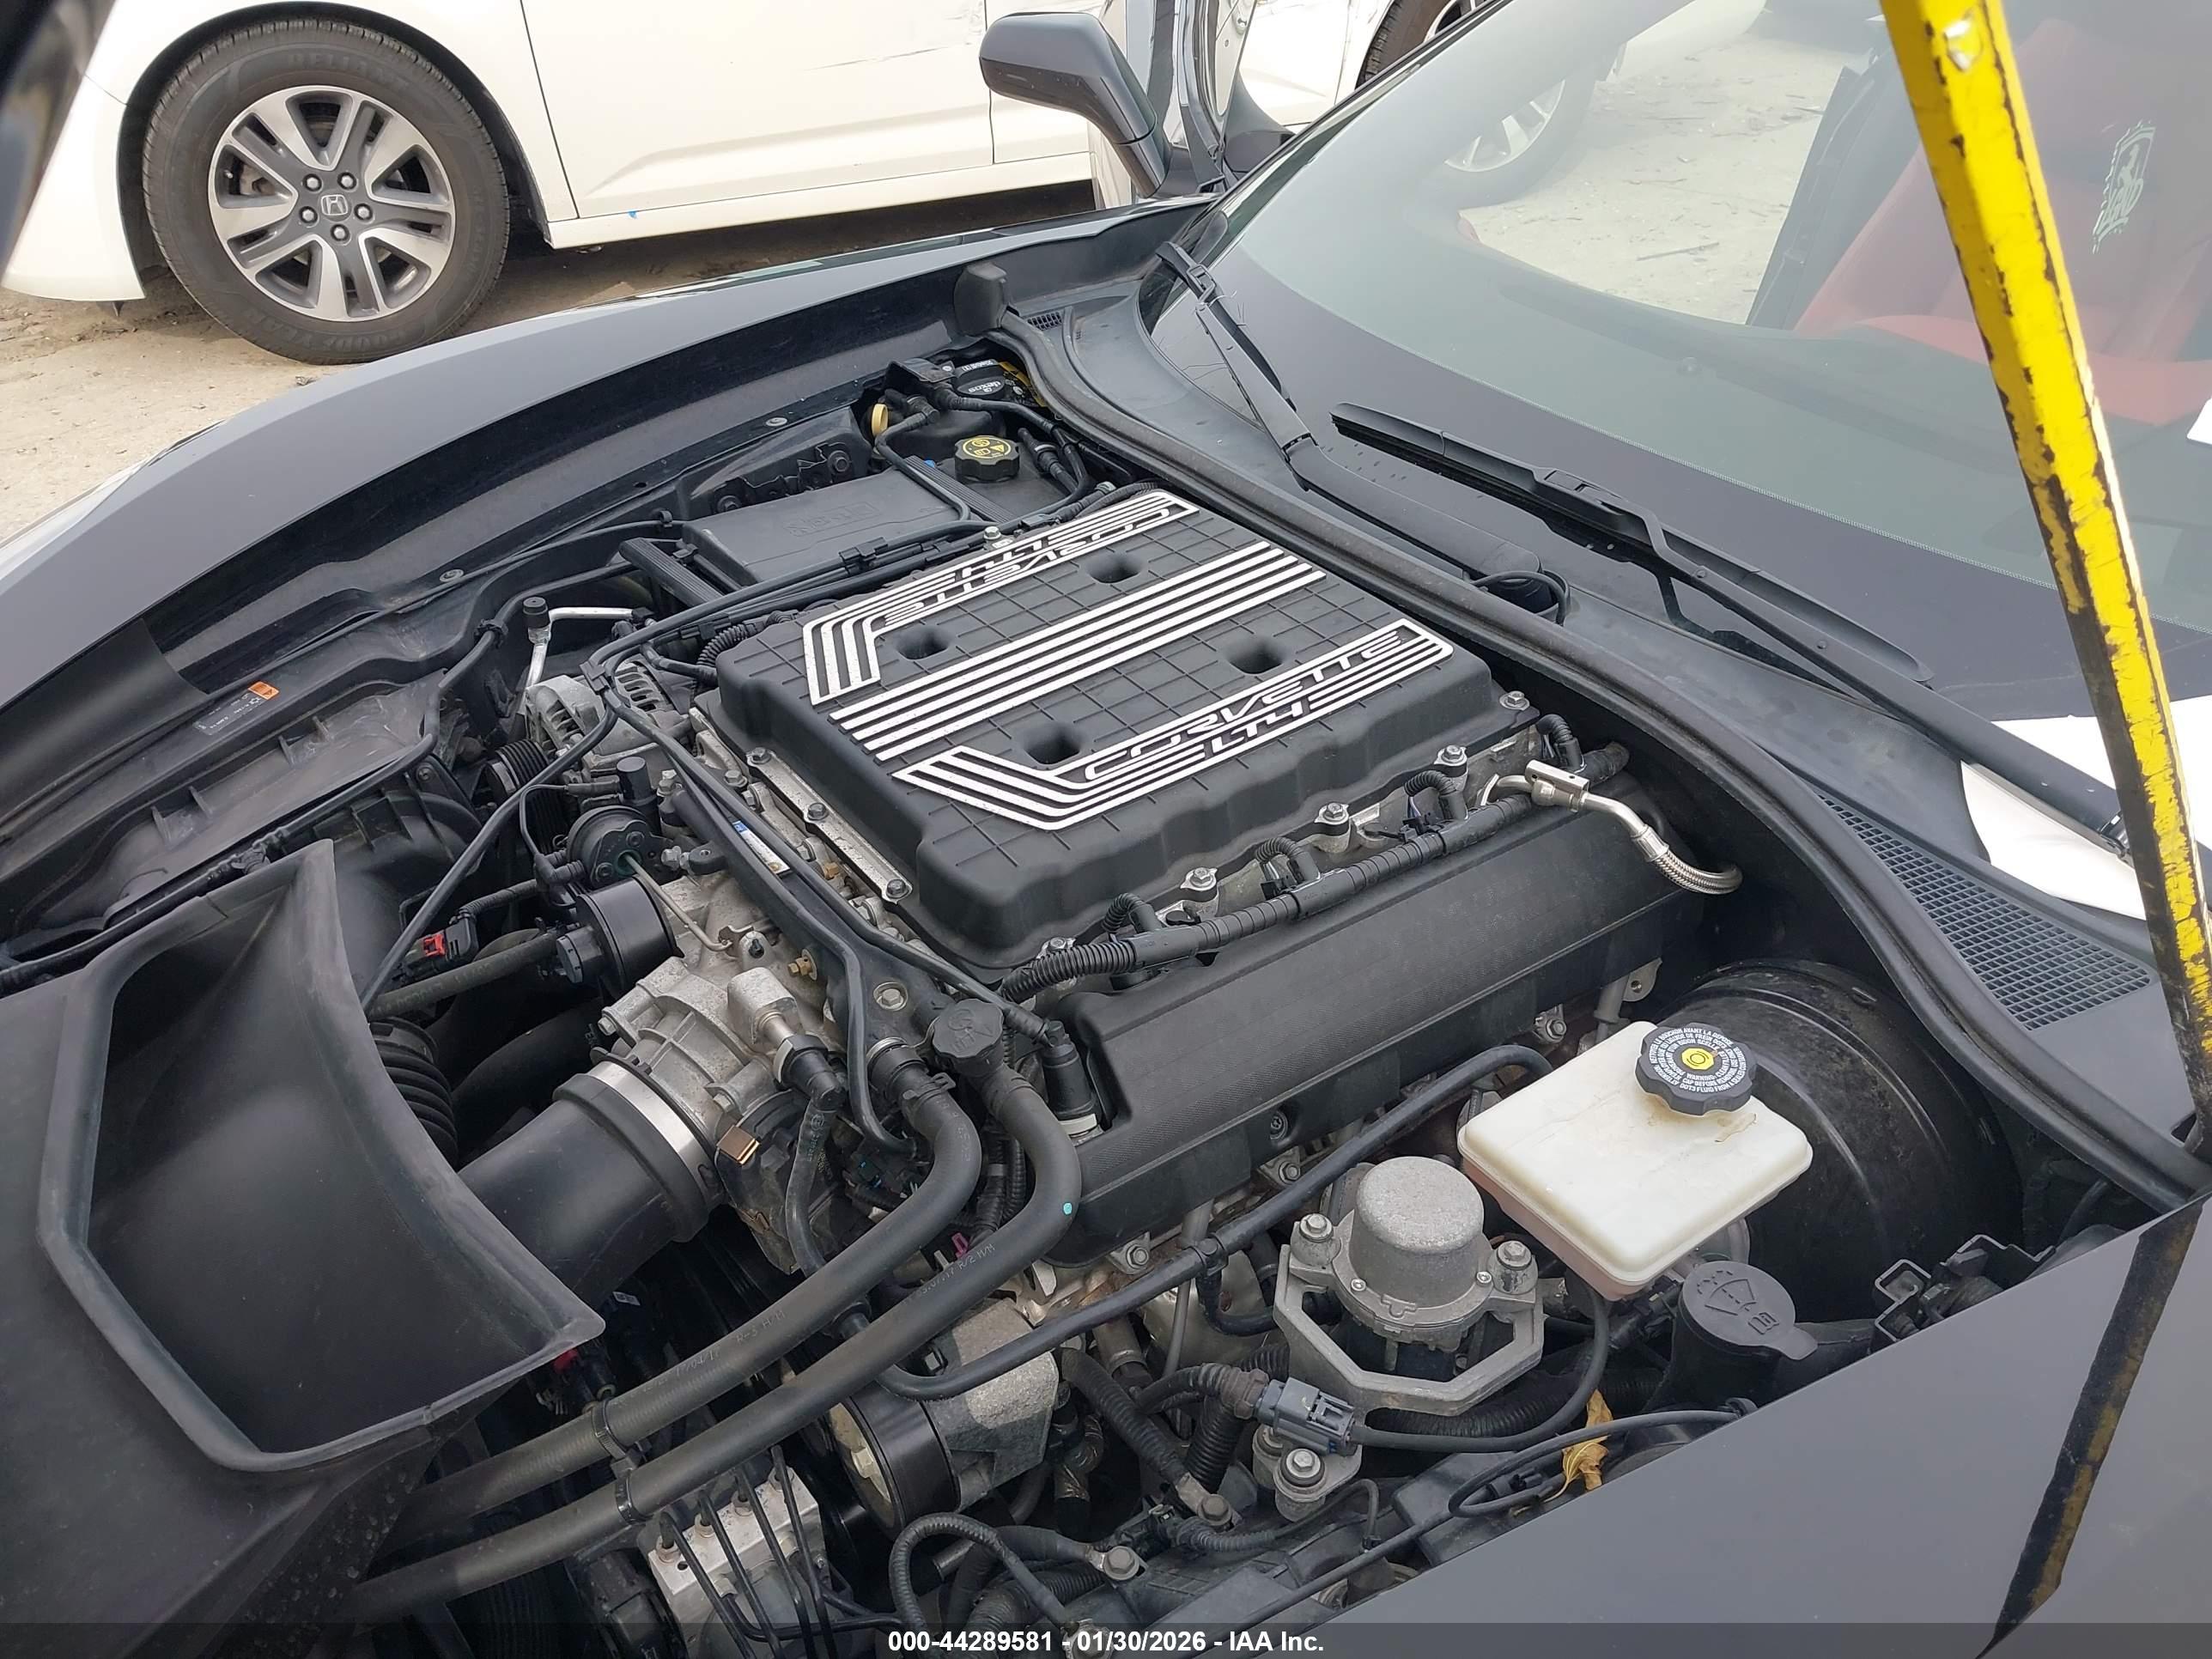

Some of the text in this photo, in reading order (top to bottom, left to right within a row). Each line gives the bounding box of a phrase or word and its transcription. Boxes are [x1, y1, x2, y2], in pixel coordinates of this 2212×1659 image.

[968, 380, 1001, 392] dexos
[884, 508, 1170, 627] CORVETTE
[962, 538, 1051, 584] LT4
[1085, 630, 1405, 781] CORVETTE
[1211, 700, 1313, 755] LT4
